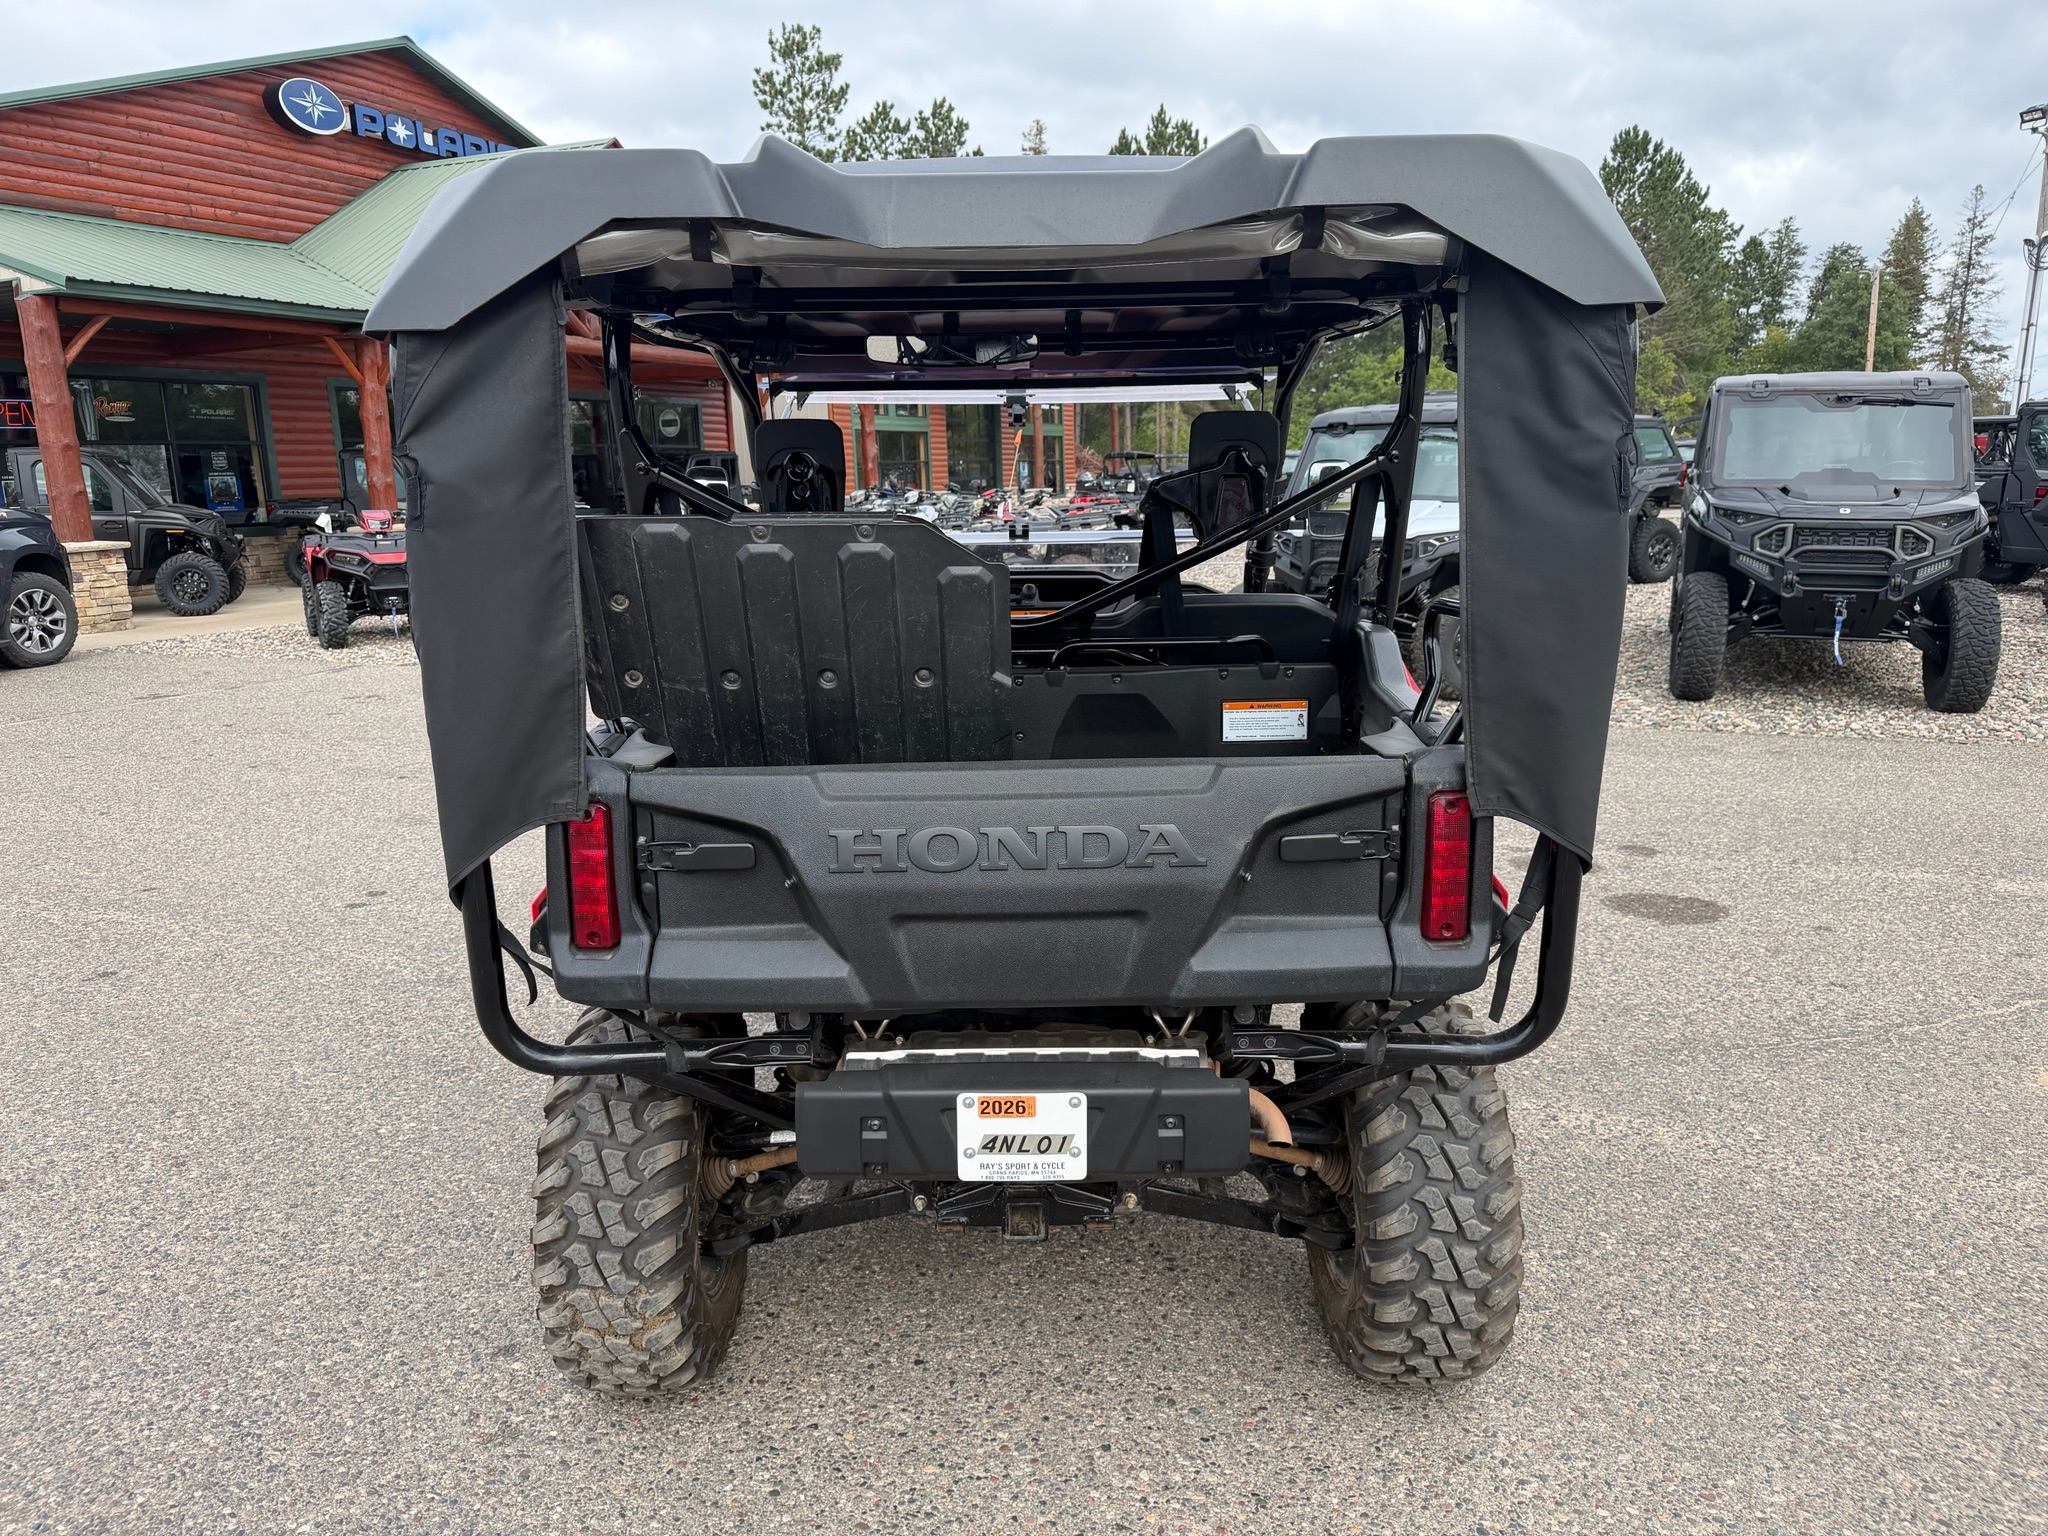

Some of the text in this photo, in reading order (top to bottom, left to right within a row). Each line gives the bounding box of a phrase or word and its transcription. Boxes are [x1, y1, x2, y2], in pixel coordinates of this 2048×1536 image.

[353, 103, 519, 158] POLAR
[1798, 536, 1889, 546] POLARIS
[827, 823, 1208, 874] HONDA
[980, 1100, 1026, 1115] 2026
[979, 1161, 1066, 1171] RAY'S SPORT & CYCLE
